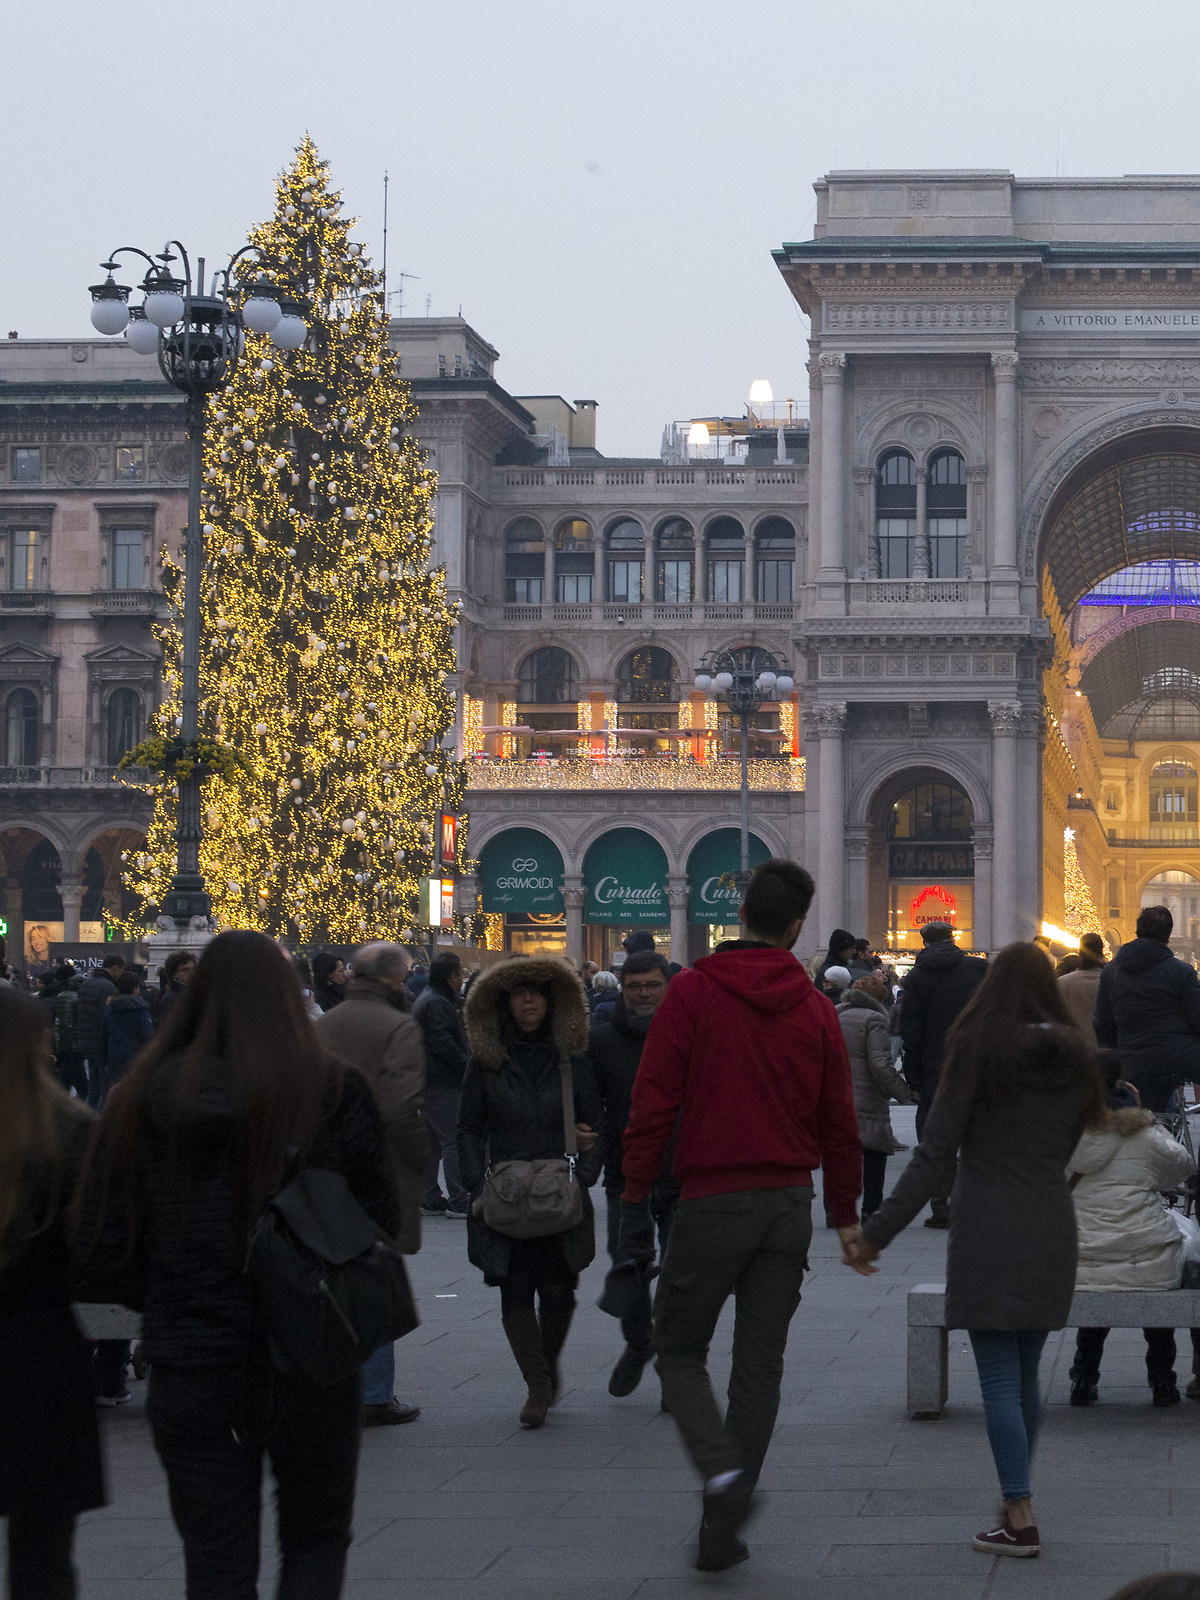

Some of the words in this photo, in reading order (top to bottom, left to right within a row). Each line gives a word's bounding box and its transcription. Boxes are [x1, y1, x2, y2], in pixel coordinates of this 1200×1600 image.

[1036, 315, 1046, 326] A
[1054, 314, 1117, 326] VITTORIO
[1125, 314, 1199, 326] EMANUELE
[443, 823, 454, 853] M
[893, 851, 975, 870] CAMPARI
[496, 877, 554, 889] GRIMOLDI
[594, 876, 662, 904] Currado
